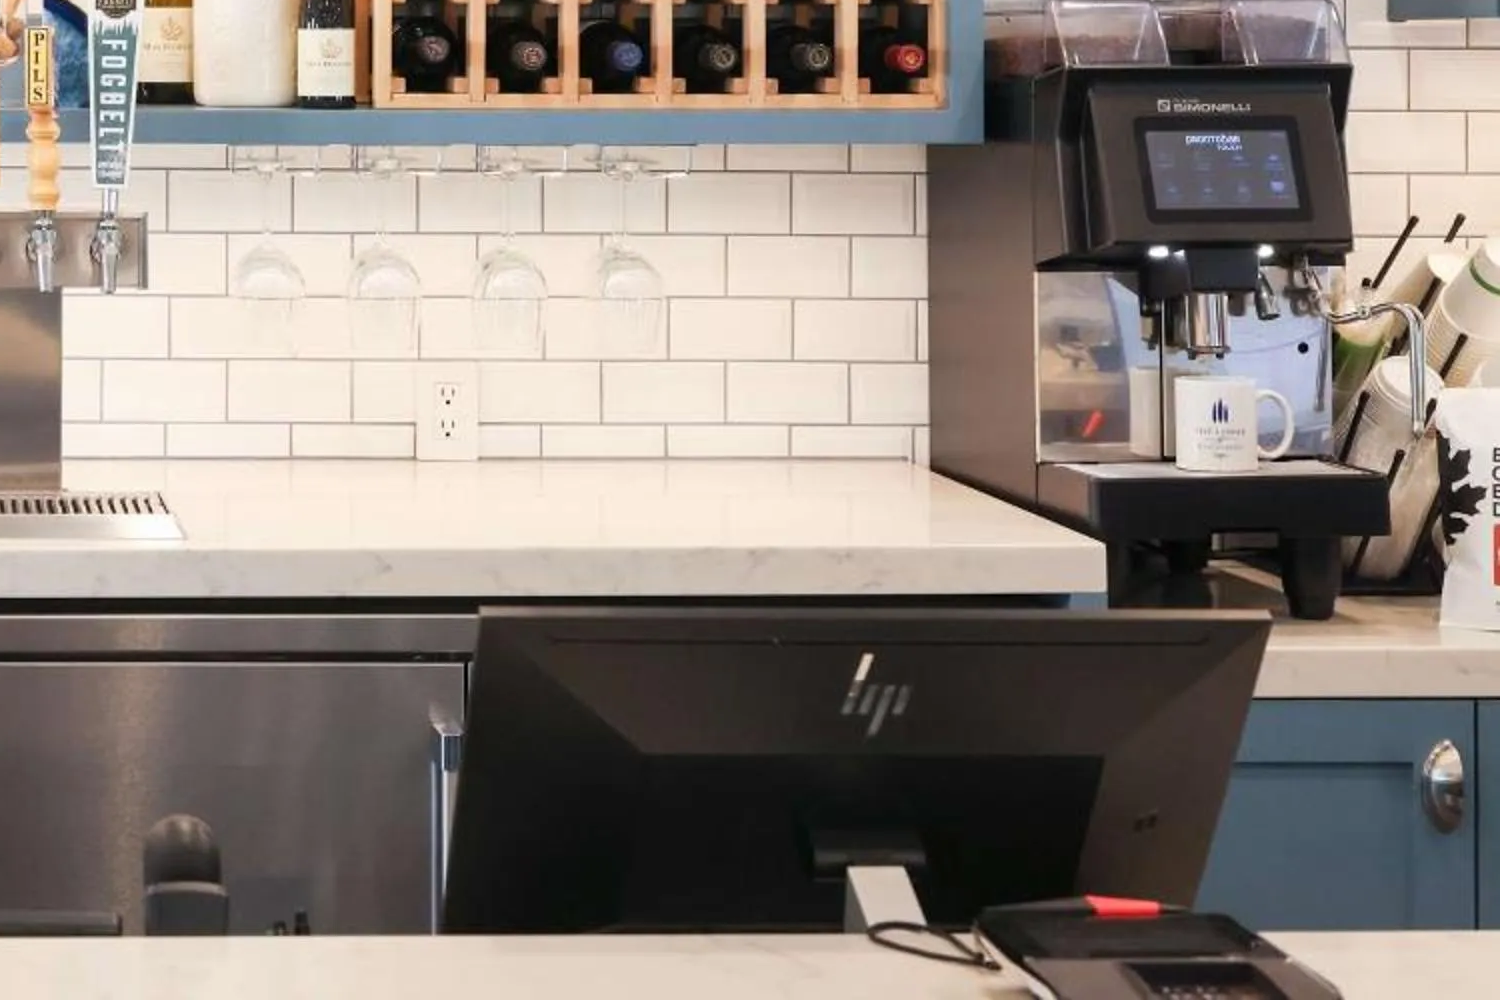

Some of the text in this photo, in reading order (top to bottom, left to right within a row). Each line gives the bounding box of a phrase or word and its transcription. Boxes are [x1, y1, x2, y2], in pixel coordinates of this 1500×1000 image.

[33, 32, 44, 101] PILS
[98, 38, 128, 152] FOGBELT
[1173, 103, 1251, 113] SIMONELLI
[841, 652, 912, 738] hp
